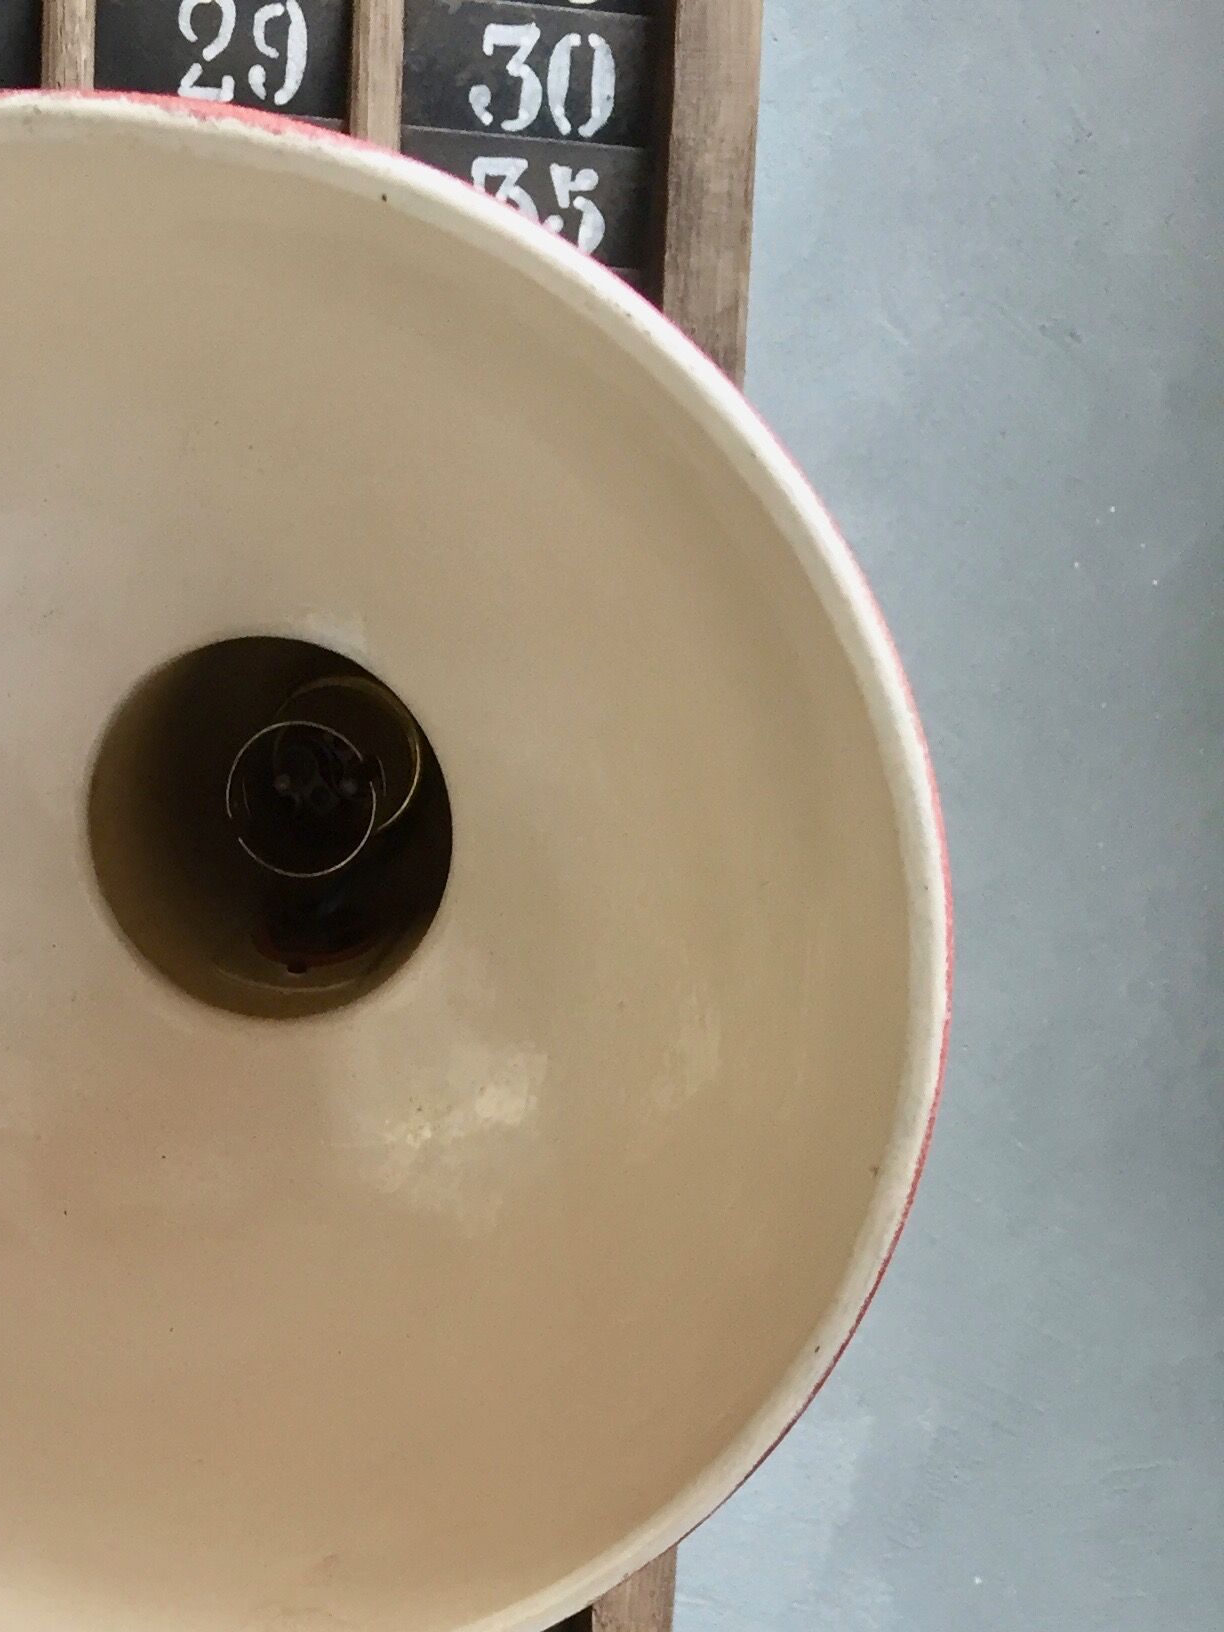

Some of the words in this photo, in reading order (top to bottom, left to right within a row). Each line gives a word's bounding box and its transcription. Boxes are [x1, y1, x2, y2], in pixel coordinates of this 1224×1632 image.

[177, 0, 308, 106] 29
[469, 22, 616, 138] 30
[471, 156, 606, 255] 35
